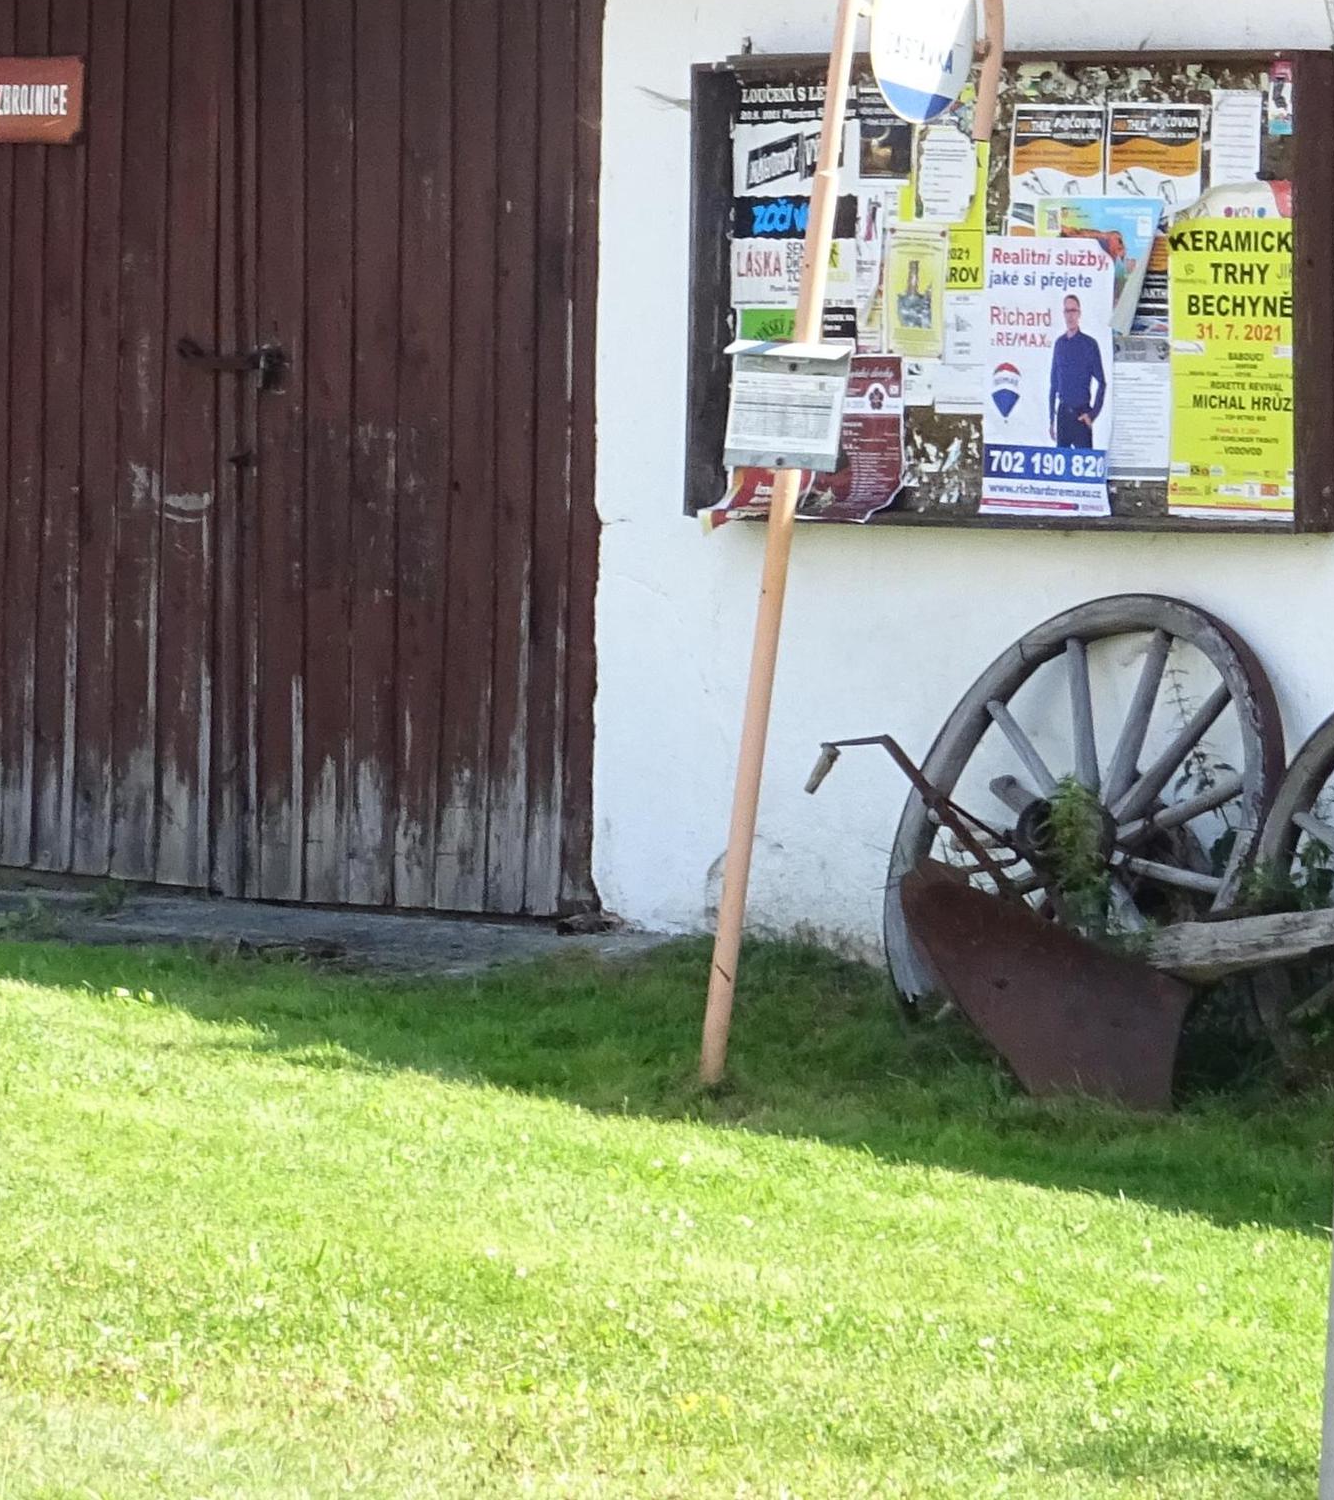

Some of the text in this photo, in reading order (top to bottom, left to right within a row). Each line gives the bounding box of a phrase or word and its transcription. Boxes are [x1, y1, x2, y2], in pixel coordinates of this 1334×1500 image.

[1168, 230, 1293, 252] KERAMICK
[737, 245, 782, 277] LÁSKA
[948, 248, 970, 260] 021
[992, 247, 1109, 271] Realitní služby,
[946, 267, 979, 283] ROV
[989, 270, 1093, 291] jaké si přejete
[1210, 263, 1269, 285] TRHY
[1187, 291, 1293, 318] BECHYNĚ
[990, 306, 1052, 327] Richard
[1196, 323, 1281, 341] 31. 7. 2021
[1249, 382, 1283, 392] REVIVAL
[1192, 392, 1293, 411] MICHAL HRŮZ
[989, 450, 1025, 473] 702
[1031, 452, 1065, 475] 190
